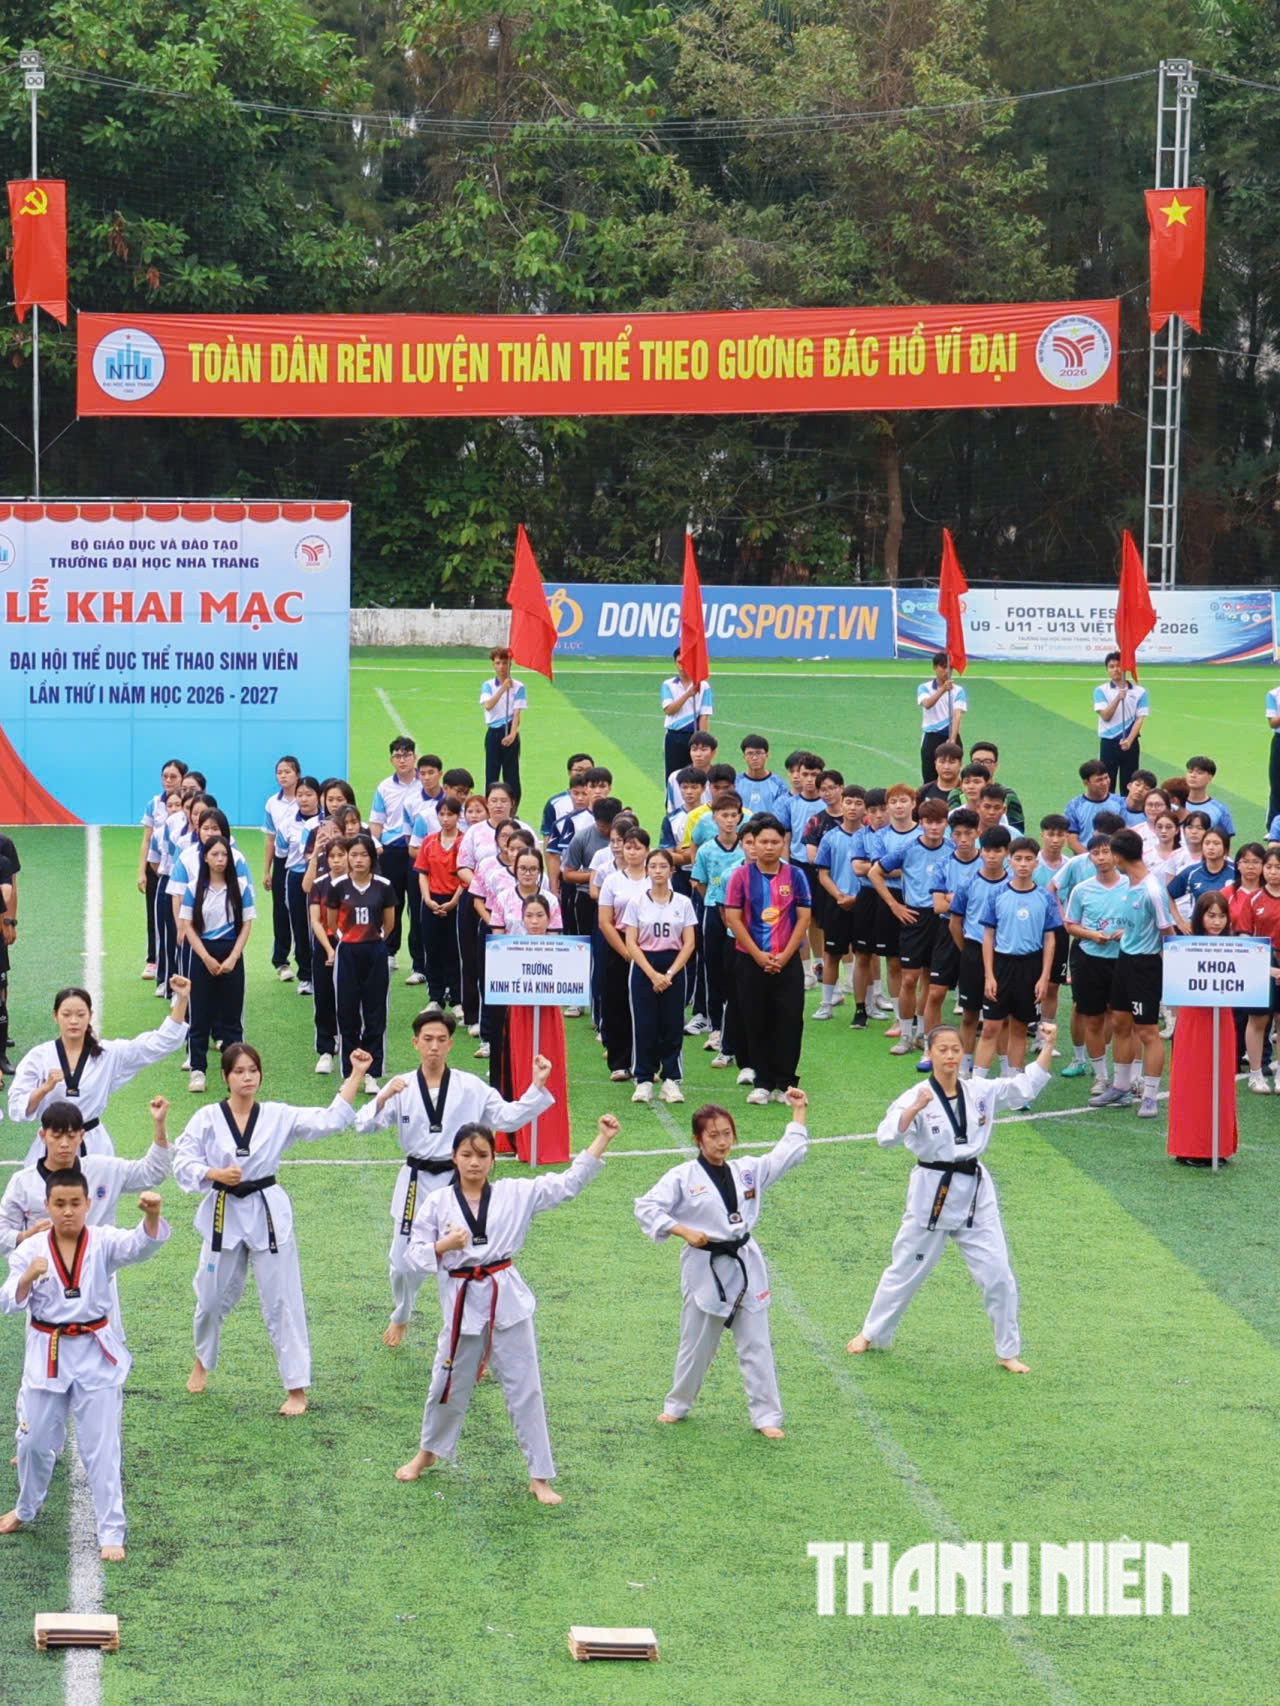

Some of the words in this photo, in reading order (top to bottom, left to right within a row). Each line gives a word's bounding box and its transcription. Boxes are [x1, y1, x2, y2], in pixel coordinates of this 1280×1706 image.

[188, 335, 261, 382] TOÀN
[271, 335, 327, 382] DÂN
[338, 335, 392, 383] RÈN
[403, 335, 488, 391] LUYỆN
[498, 334, 570, 381] THÂN
[580, 325, 632, 381] THỂ
[640, 340, 708, 380] THEO
[719, 335, 814, 379] GƯƠNG
[824, 329, 879, 376] BÁC
[889, 322, 926, 375] HỒ
[935, 327, 963, 373] VĨ
[970, 333, 1017, 381] ĐẠI
[110, 364, 148, 380] NTU
[1059, 368, 1088, 377] 2026
[71, 538, 89, 552] BỘ
[93, 538, 124, 551] GIÁO
[129, 540, 156, 552] DỤC
[160, 538, 177, 550] VÀ
[181, 538, 208, 550] ĐÀO
[213, 540, 238, 552] TẠO
[50, 556, 108, 569] TRƯỜNG
[113, 557, 137, 570] ĐẠI
[142, 557, 171, 570] HỌC
[176, 557, 206, 569] NHA
[212, 557, 259, 569] TRANG
[6, 577, 51, 623] LỄ
[66, 592, 183, 623] KHAI
[200, 592, 303, 630] MẠC
[597, 601, 879, 641] DONGUCSPORT.VN
[1007, 607, 1085, 619] FOOTBALL
[970, 620, 991, 632] U9
[1005, 621, 1032, 632] U11
[1047, 621, 1076, 633] U13
[1080, 619, 1114, 636] VIỆT
[1160, 623, 1199, 634] 2026
[10, 651, 36, 674] ĐẠI
[42, 648, 67, 674] HỘI
[72, 644, 102, 670] THỂ
[106, 651, 136, 674] DỤC
[142, 644, 170, 670] THỂ
[175, 651, 214, 670] THAO
[220, 651, 257, 670] SINH
[263, 648, 298, 670] VIÊN
[30, 681, 61, 704] LẦN
[65, 685, 96, 704] THỨ
[99, 686, 104, 704] I
[108, 683, 145, 704] NĂM
[150, 685, 181, 708] HỌC
[186, 686, 224, 704] 2026
[240, 686, 278, 705] 2027
[354, 906, 370, 925] 18
[653, 922, 671, 938] 06
[1197, 960, 1236, 973] KHOA
[490, 981, 510, 993] KINH
[535, 981, 555, 993] KINH
[557, 982, 584, 994] DOANH
[1188, 978, 1208, 991] DU
[1212, 979, 1245, 995] LỊCH
[1131, 1001, 1143, 1016] 31
